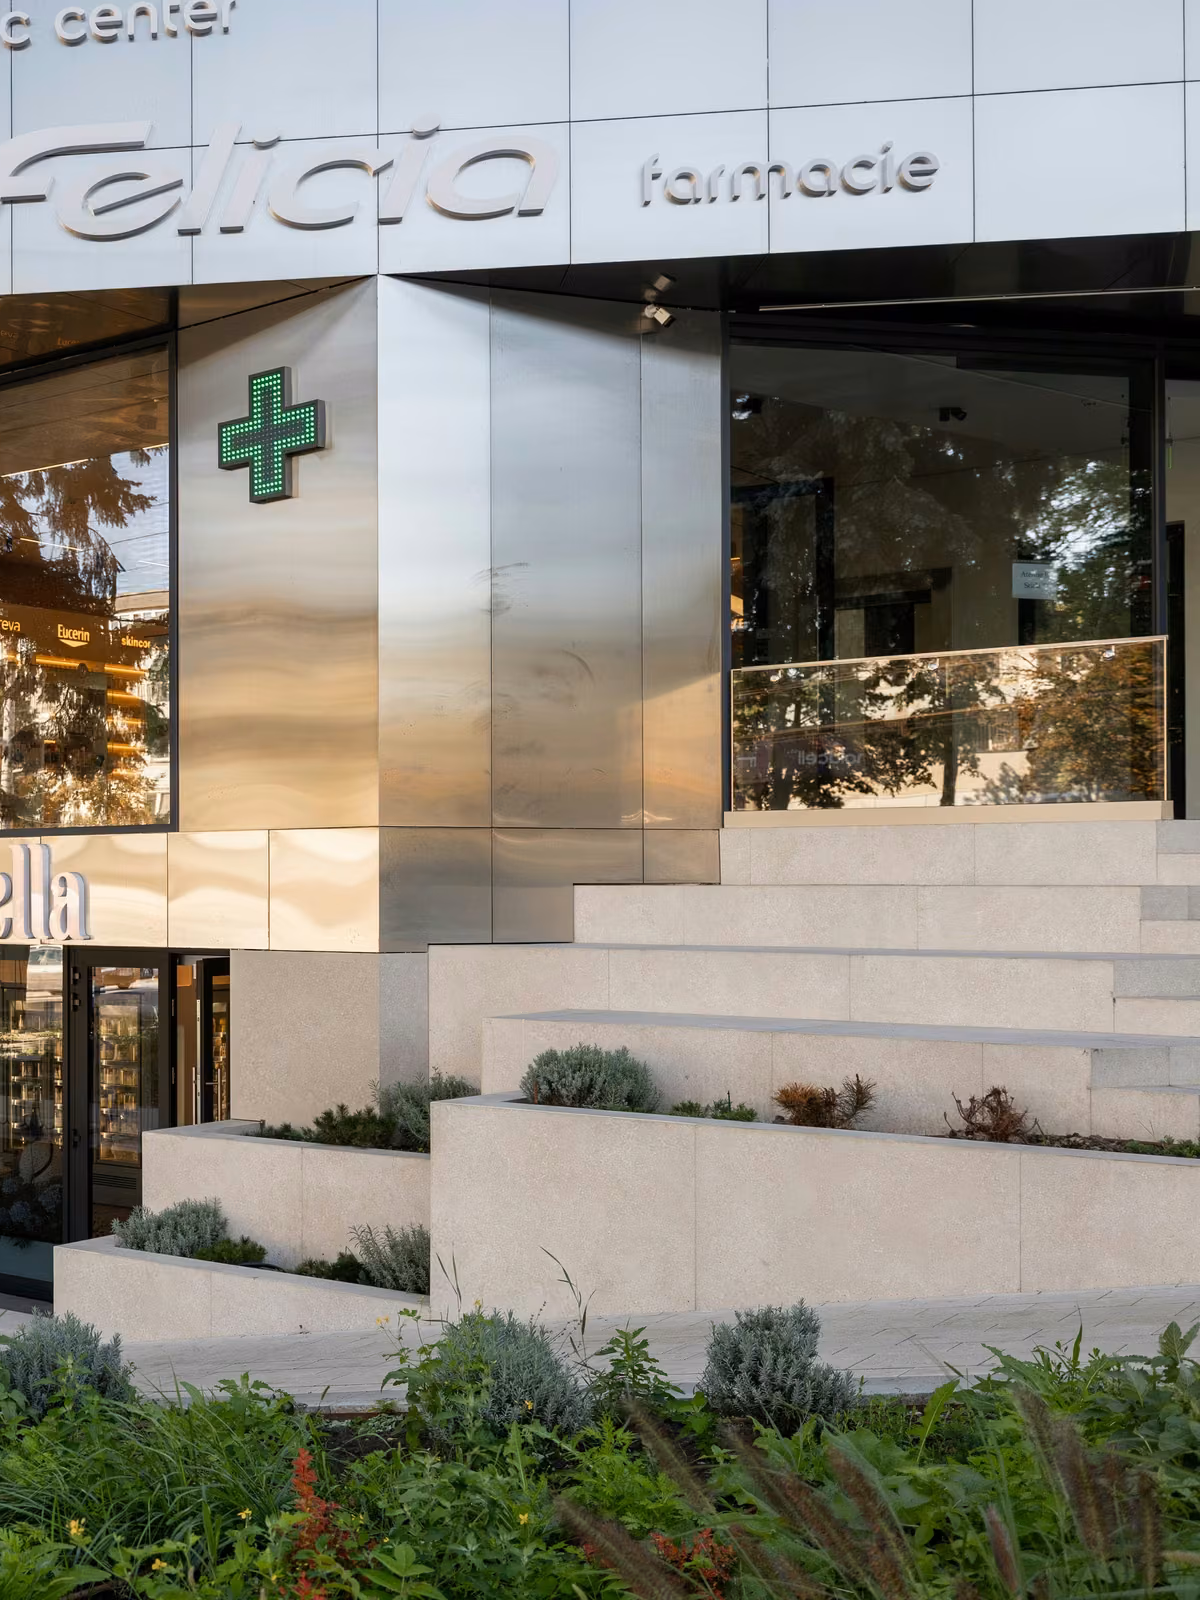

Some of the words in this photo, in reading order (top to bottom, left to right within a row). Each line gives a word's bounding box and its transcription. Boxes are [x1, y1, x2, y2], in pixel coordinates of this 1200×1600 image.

[53, 0, 237, 47] center
[639, 140, 942, 207] farmacie
[57, 624, 90, 642] Eucerin
